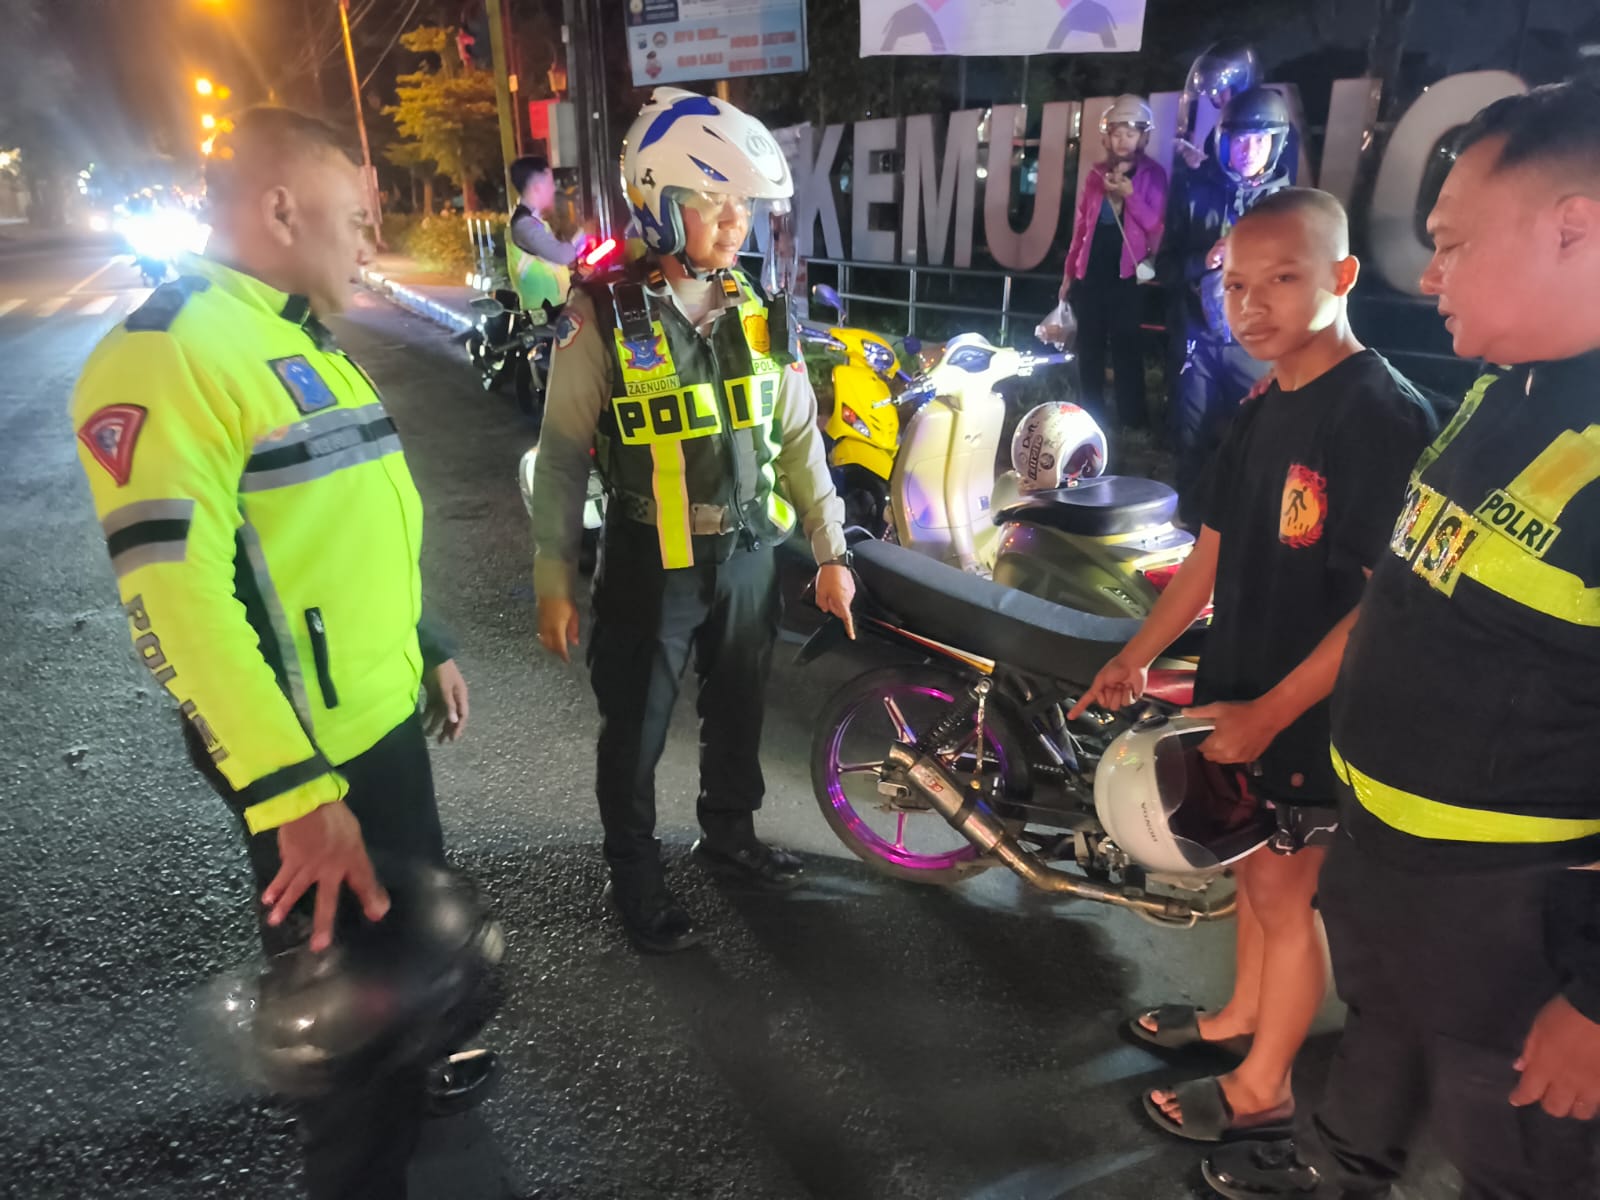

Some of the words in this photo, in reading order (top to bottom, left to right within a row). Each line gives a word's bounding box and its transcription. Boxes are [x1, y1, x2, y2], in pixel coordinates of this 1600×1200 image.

[616, 379, 774, 438] POLIS
[628, 379, 677, 395] ZAENUDIN
[1478, 493, 1554, 552] POLRI
